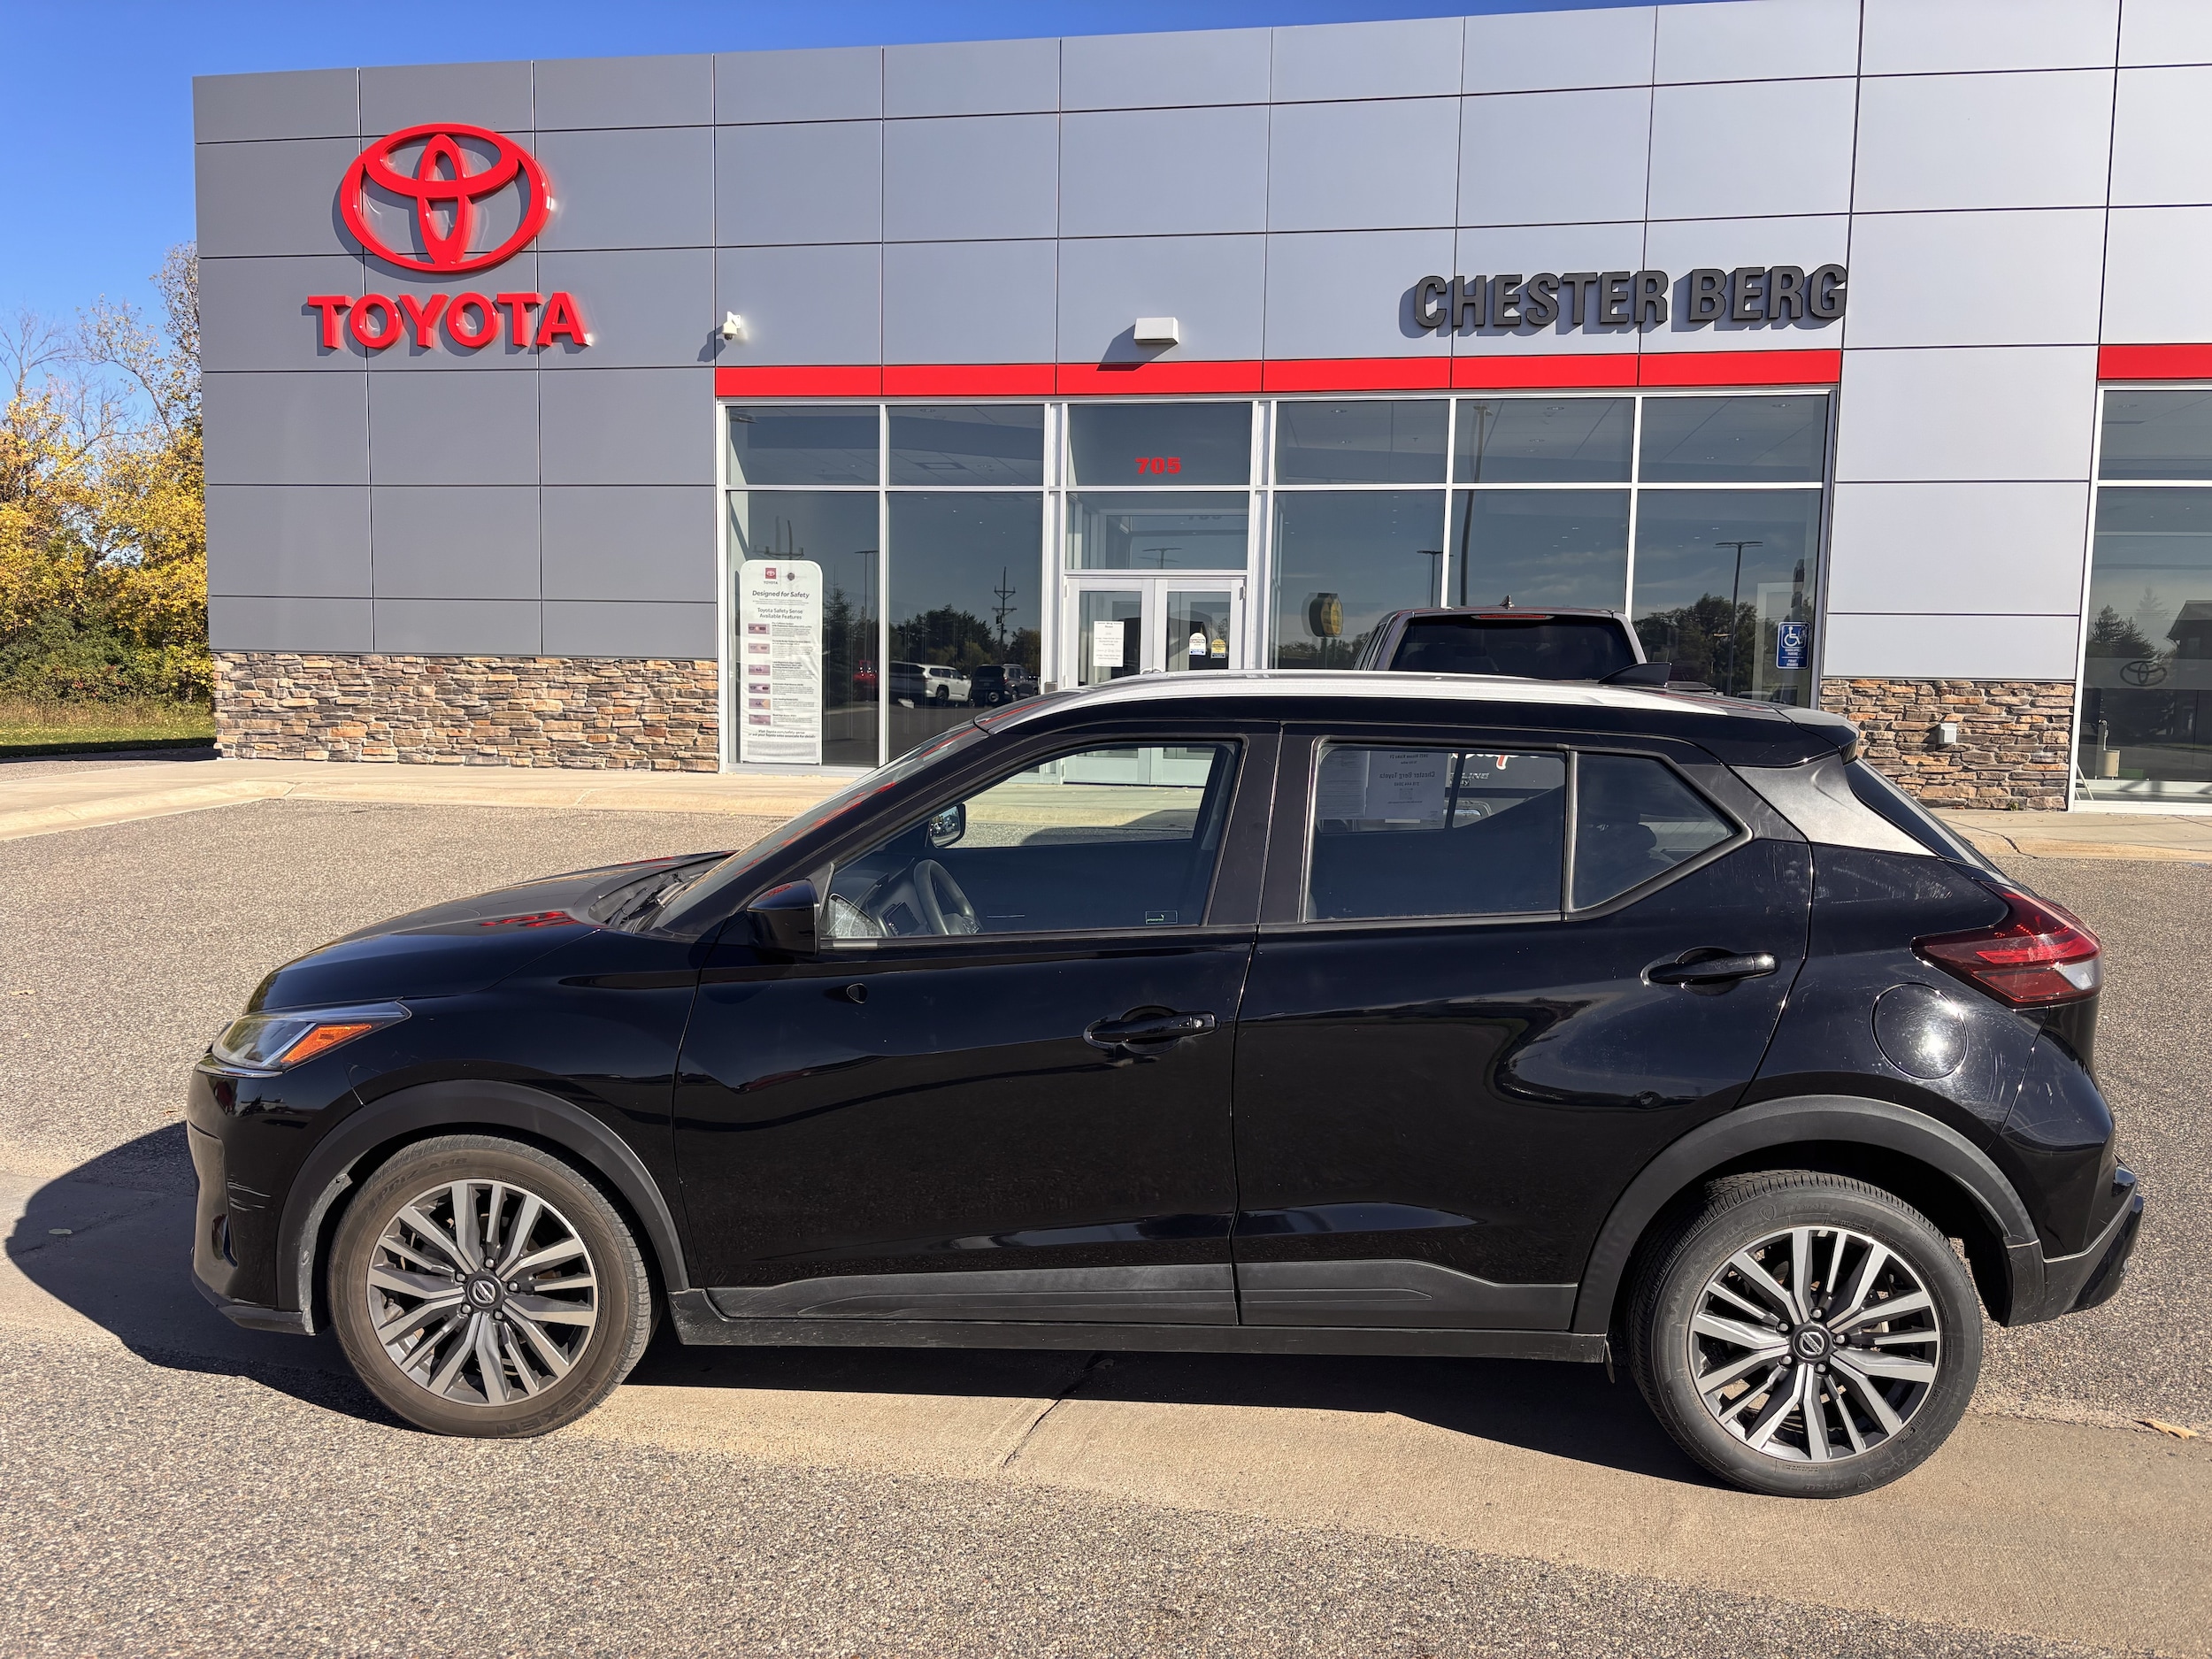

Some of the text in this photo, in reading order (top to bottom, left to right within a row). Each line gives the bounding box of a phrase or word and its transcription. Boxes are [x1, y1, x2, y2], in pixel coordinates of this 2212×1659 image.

[1415, 264, 1847, 328] CHESTER BERG
[308, 291, 591, 350] TOYOTA
[1135, 457, 1181, 474] 705
[1804, 1334, 1821, 1353] NISSAN
